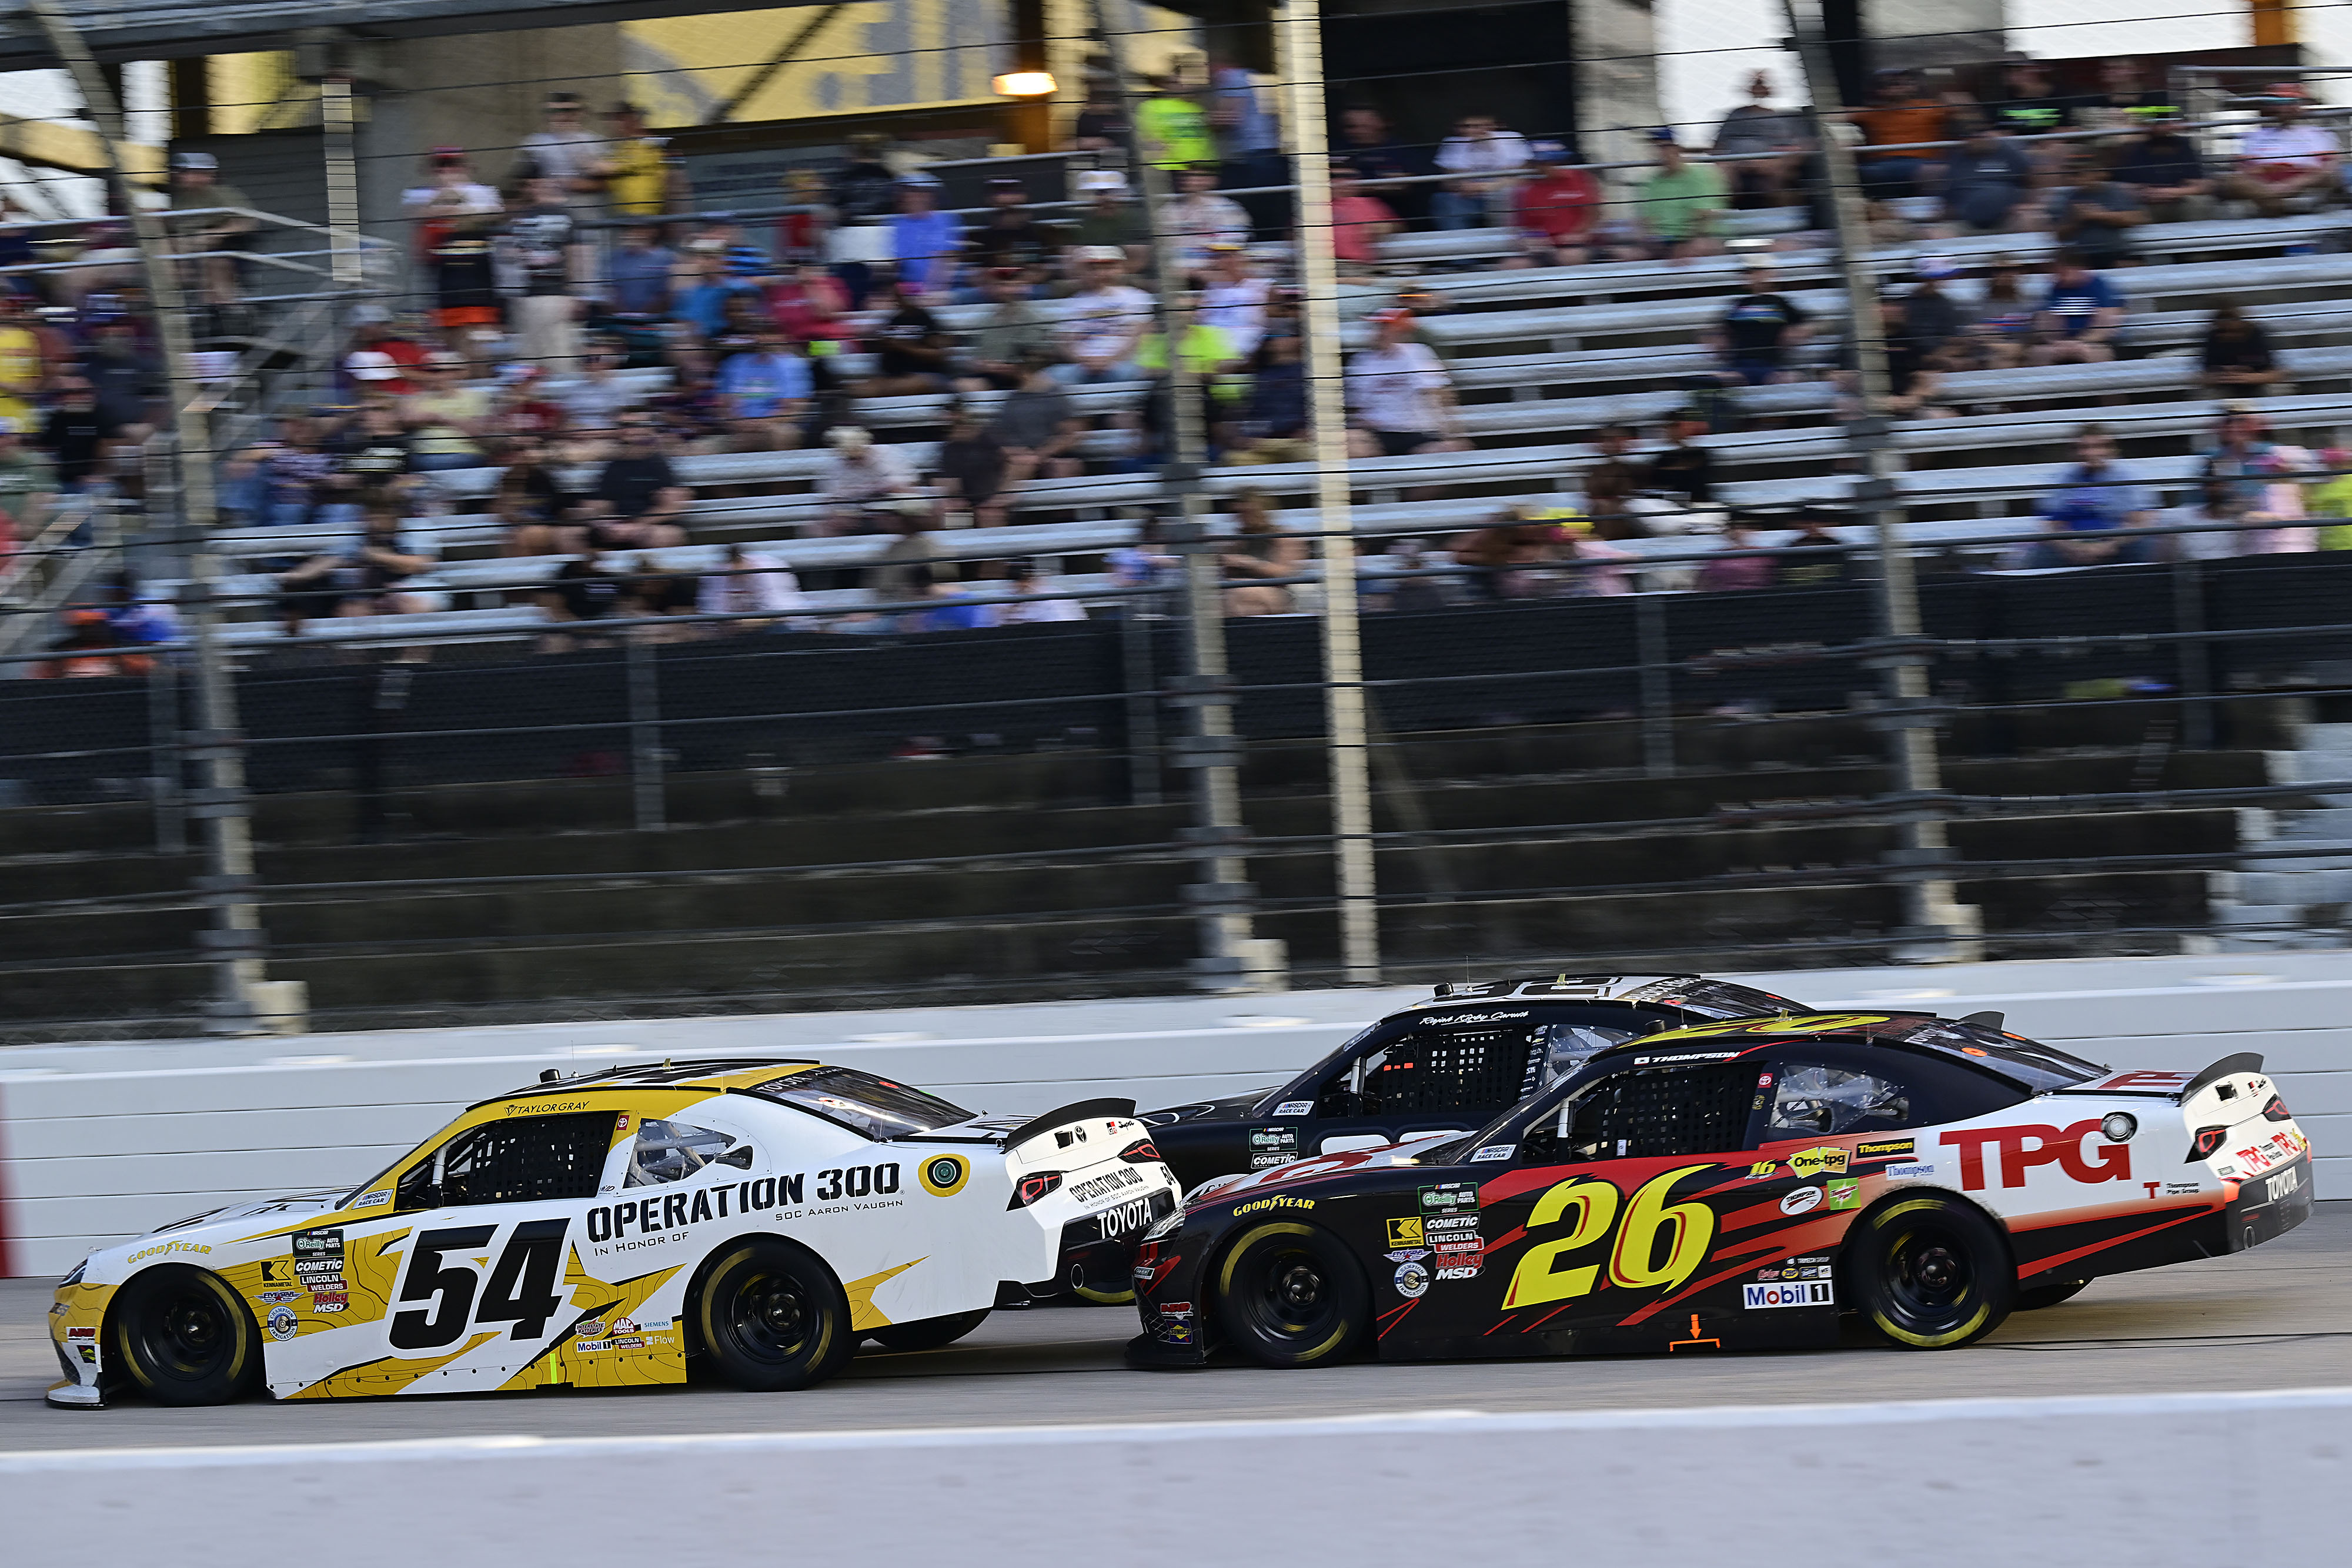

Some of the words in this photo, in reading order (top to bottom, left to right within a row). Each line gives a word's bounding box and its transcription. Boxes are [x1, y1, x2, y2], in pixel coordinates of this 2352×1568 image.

[1652, 1051, 1741, 1063] THOMPSON
[756, 1076, 812, 1092] TOYOTA
[518, 1104, 557, 1114] TAYLOR
[558, 1101, 590, 1111] GRAY
[1254, 1134, 1280, 1144] O'Reilly
[1858, 1142, 1913, 1153] Thompson
[1253, 1155, 1295, 1165] COMETIC
[1795, 1154, 1845, 1168] One-tpg
[1939, 1118, 2132, 1191] TPG
[1749, 1159, 1778, 1175] 16
[1160, 1165, 1176, 1186] 54
[1069, 1172, 1126, 1203] OPERATION
[1118, 1166, 1143, 1185] 300
[2265, 1166, 2298, 1202] TOYOTA
[368, 1191, 387, 1199] NASCAR
[587, 1172, 806, 1243] OPERATION
[817, 1162, 900, 1201] 300
[1233, 1197, 1315, 1216] GOODYEAR
[775, 1210, 803, 1221] SOC
[807, 1205, 848, 1217] AARON
[853, 1199, 903, 1211] VAUGHN
[1097, 1197, 1152, 1239] TOYOTA
[1426, 1216, 1478, 1229] COMETIC
[1429, 1233, 1474, 1243] LINCOLN
[1501, 1164, 1717, 1310] 26
[297, 1239, 325, 1249] O'Reilly
[594, 1246, 609, 1257] IN
[616, 1237, 664, 1253] HONOR
[671, 1232, 689, 1242] OF
[1440, 1242, 1479, 1251] WELDERS
[128, 1242, 212, 1263] GOODYEAR
[296, 1259, 343, 1272] COMETIC
[1436, 1253, 1482, 1269] Holley
[302, 1274, 339, 1284] LINCOLN
[1435, 1268, 1478, 1281] MSD
[389, 1217, 572, 1350] 54
[314, 1292, 349, 1305] Holley
[1747, 1284, 1806, 1306] Mobil
[270, 1308, 294, 1319] CHAMPION
[313, 1303, 344, 1313] MSD
[613, 1318, 633, 1330] MAC
[271, 1327, 295, 1339] IRRIGATION
[654, 1335, 675, 1345] Flow
[577, 1342, 602, 1352] Mobil
